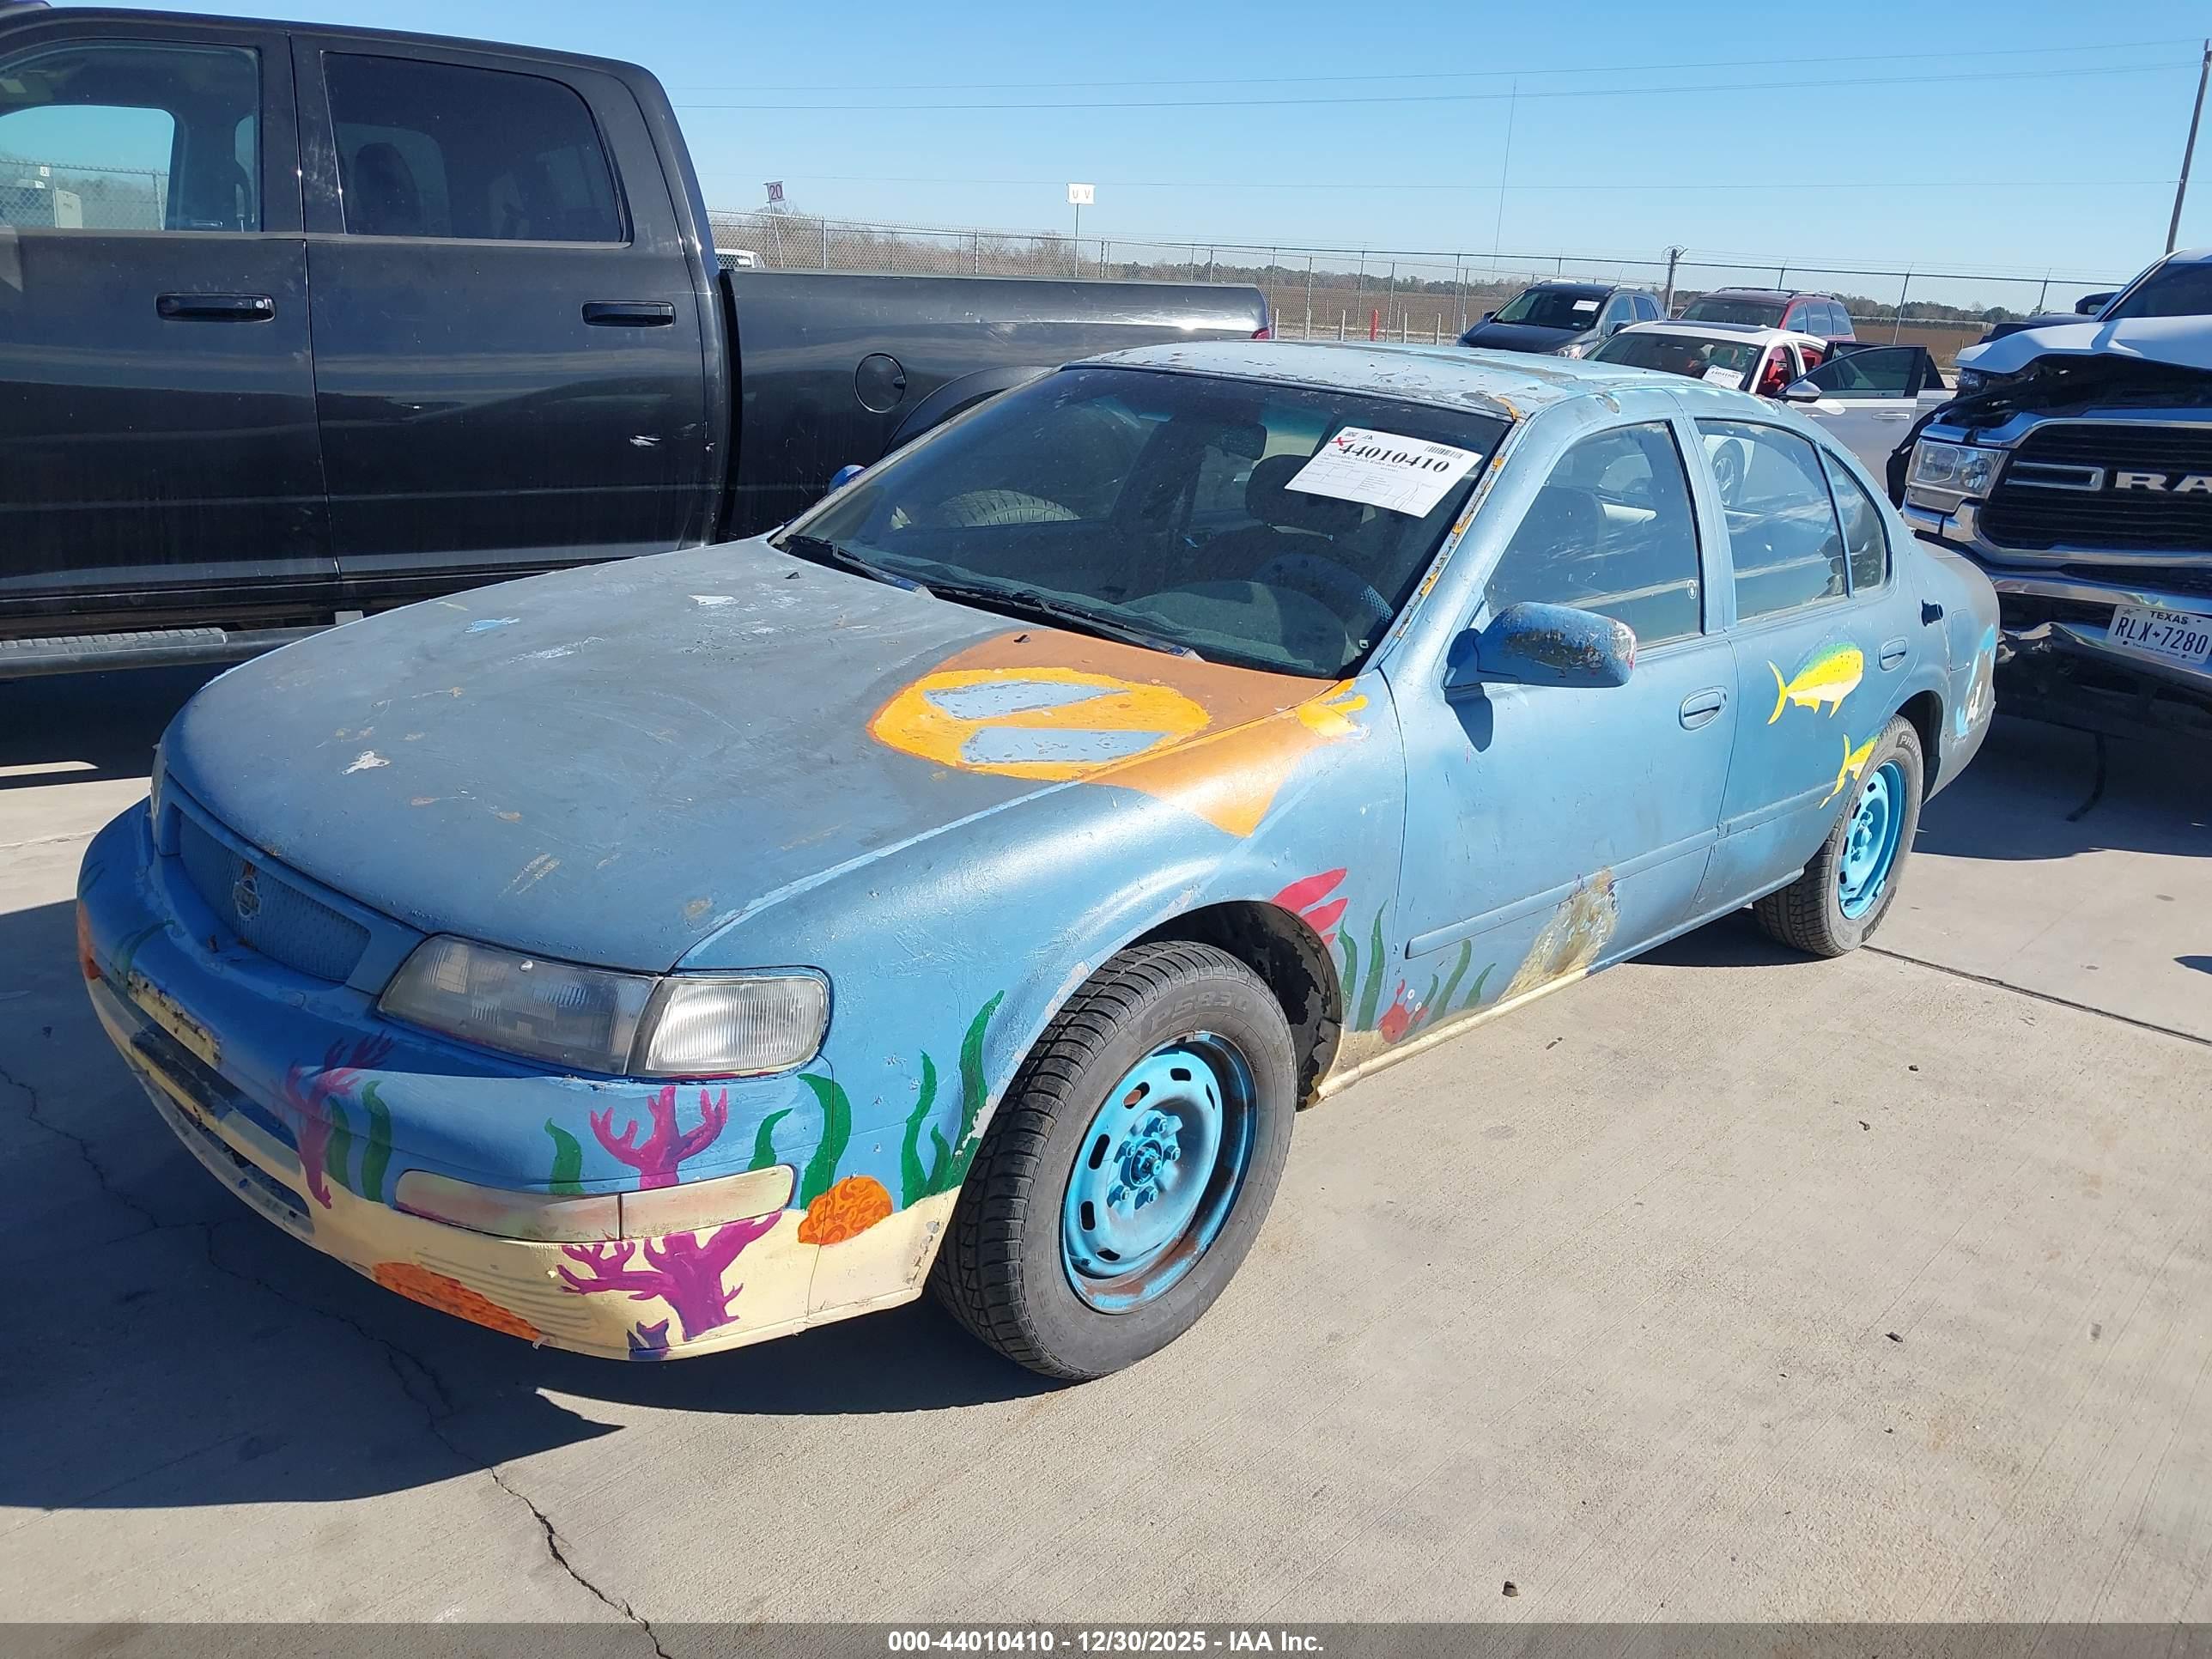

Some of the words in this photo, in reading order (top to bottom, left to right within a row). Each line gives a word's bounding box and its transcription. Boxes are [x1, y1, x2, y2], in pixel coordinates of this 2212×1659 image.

[769, 184, 782, 200] 20
[1339, 443, 1449, 473] 44010410
[2150, 611, 2189, 625] TEXAS
